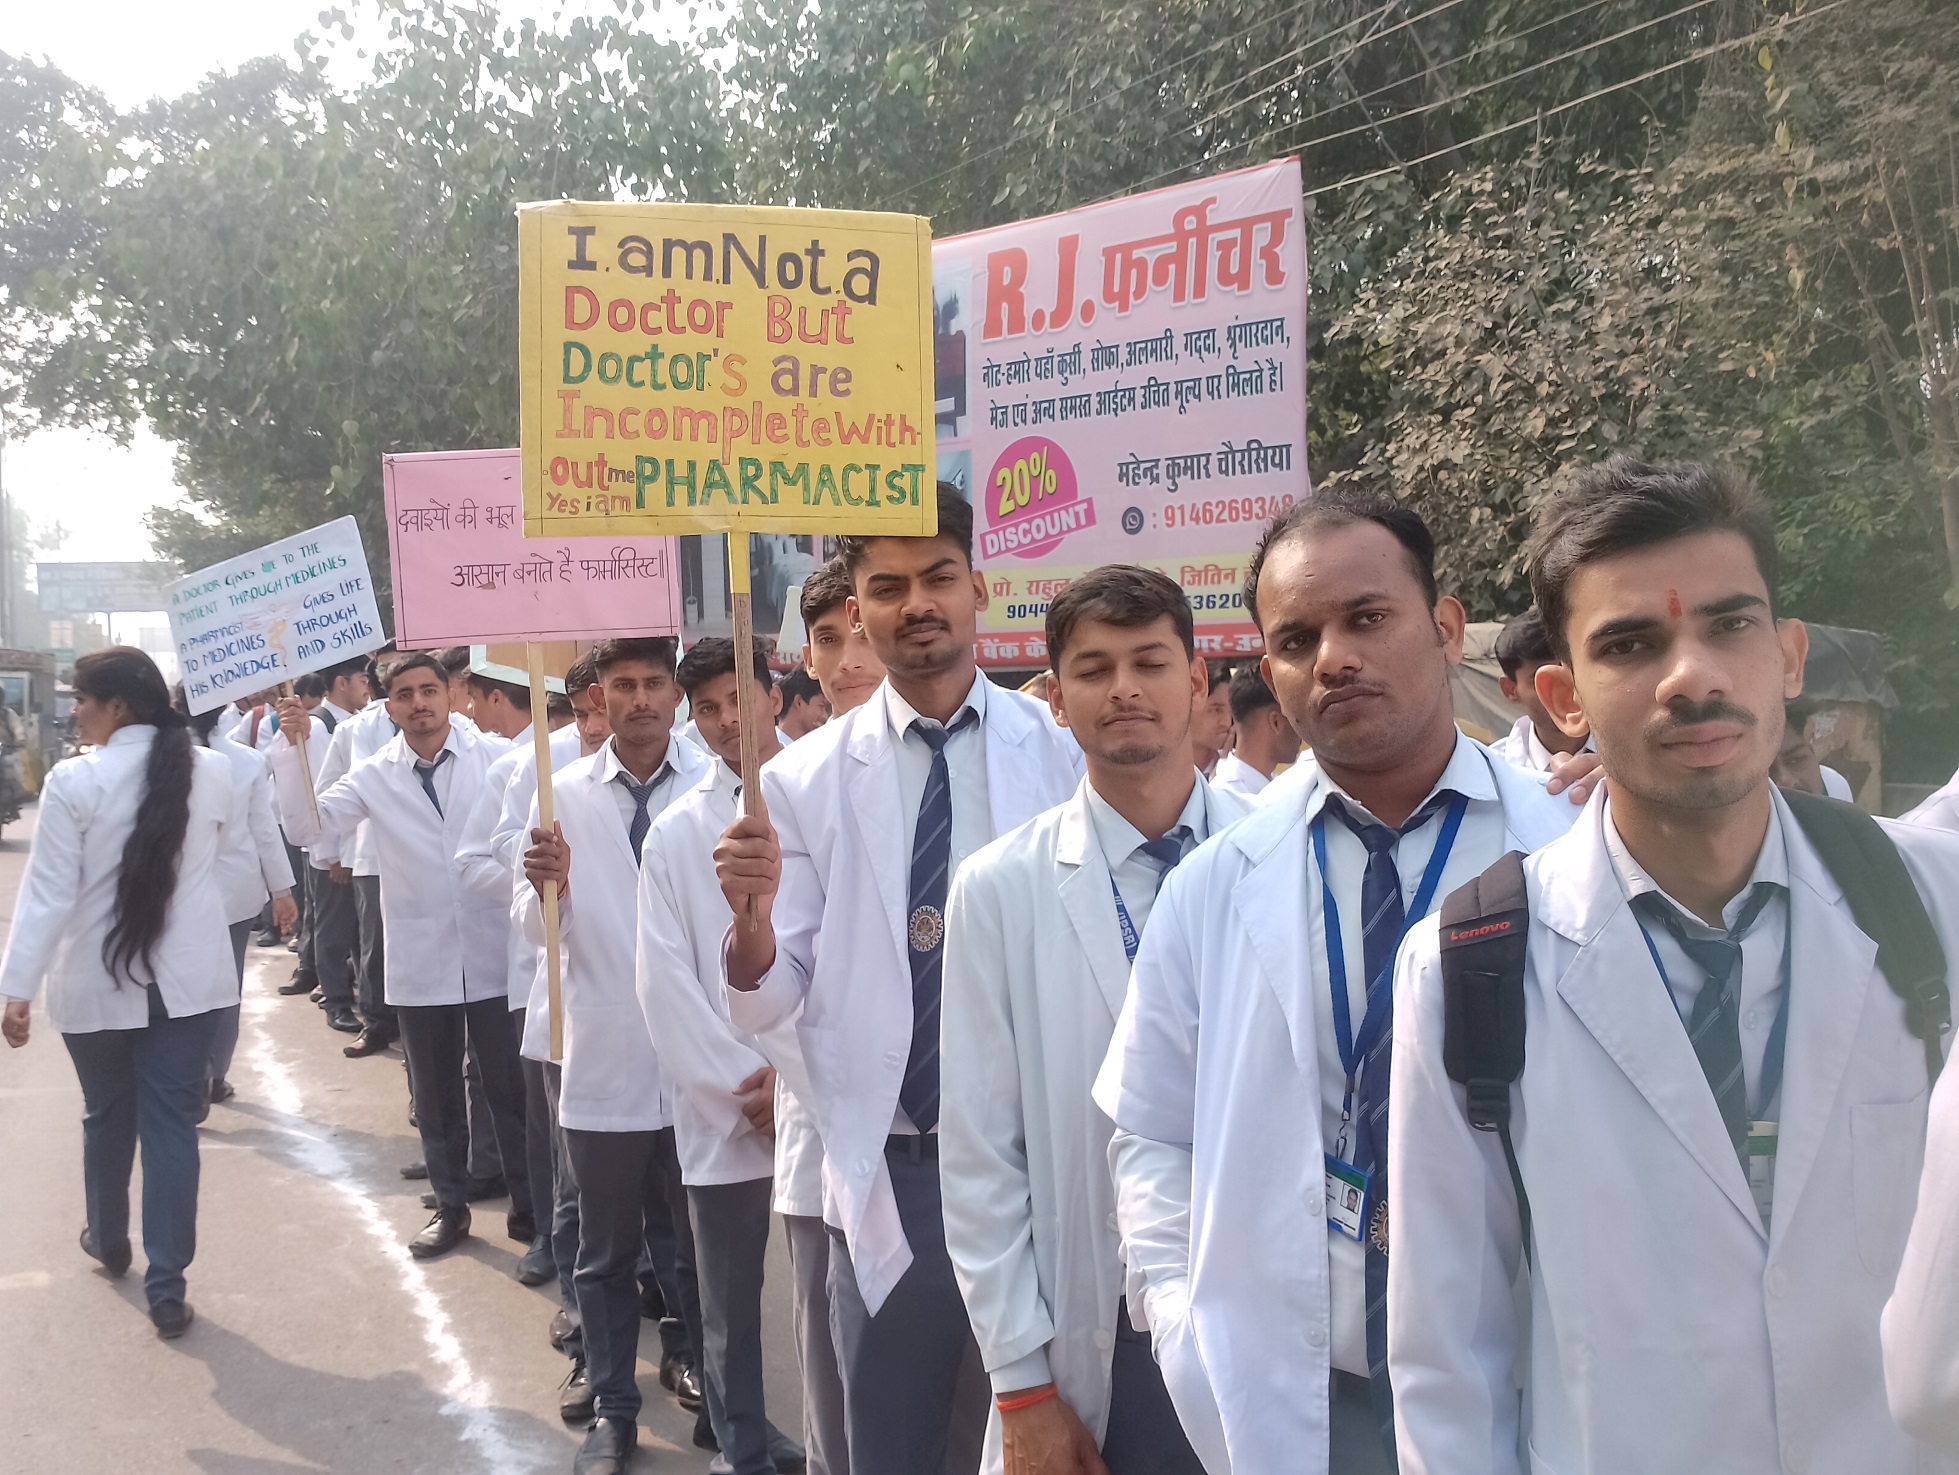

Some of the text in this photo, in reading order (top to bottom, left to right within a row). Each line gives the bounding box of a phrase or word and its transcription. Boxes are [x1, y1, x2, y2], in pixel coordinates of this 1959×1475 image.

[843, 249, 880, 306] a
[983, 196, 1293, 341] R.J. फर्नीचर
[564, 285, 855, 346] Doctor But
[771, 353, 853, 398] are
[989, 399, 1009, 430] मेज
[1012, 393, 1029, 427] एवं
[1031, 399, 1056, 425] अन्य
[1059, 393, 1092, 421] समस्त
[1095, 380, 1137, 418] आईटम
[1140, 376, 1171, 410] उचित
[1174, 377, 1202, 415] मूल्य
[1206, 374, 1223, 401] पर
[1225, 360, 1264, 399] मिलते
[996, 445, 1058, 518] 20%
[1117, 439, 1293, 493] महेन्द्र कुमार चौरसिया
[454, 498, 480, 530] की
[485, 505, 518, 530] भूल
[546, 491, 581, 516] Yes
[594, 493, 632, 515] am
[985, 502, 1089, 556] DISCOUNT
[182, 579, 222, 602] DOCTOR
[281, 552, 295, 565] TO
[298, 541, 322, 558] THE
[227, 578, 284, 607] THROUGH
[284, 554, 347, 588] MEDICINES
[302, 590, 335, 614] GIVES
[339, 577, 365, 597] LIFE
[450, 563, 512, 589] आसान
[512, 552, 554, 585] बनाते
[184, 603, 359, 674] TO MEDICINES THROUGH
[189, 683, 209, 699] HIS
[297, 638, 326, 660] AND
[1450, 921, 1512, 941] Lenovo
